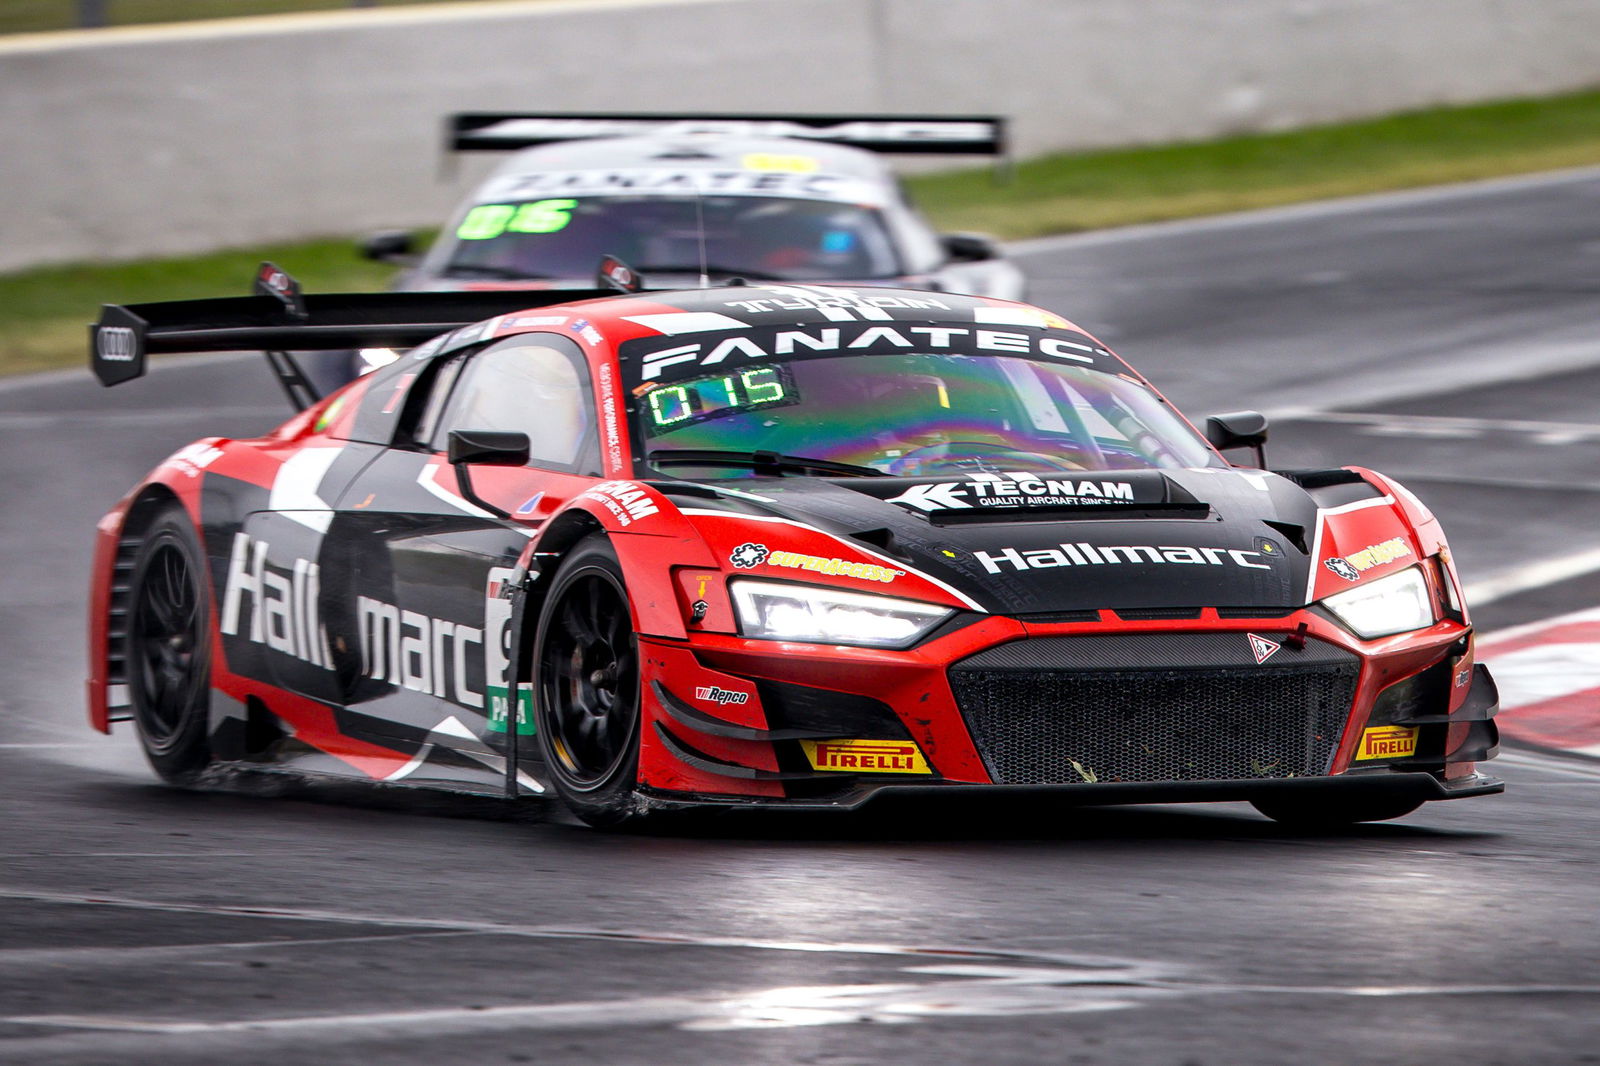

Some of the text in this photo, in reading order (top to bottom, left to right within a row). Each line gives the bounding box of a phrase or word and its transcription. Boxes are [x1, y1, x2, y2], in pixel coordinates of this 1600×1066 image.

[642, 326, 1094, 381] FANATEC
[965, 480, 1134, 500] TECNAM
[979, 496, 1024, 506] QUALITY
[1027, 497, 1078, 505] AIRCRAFT
[973, 543, 1272, 575] Hallmarc
[709, 686, 748, 704] Repco
[1366, 731, 1414, 755] PIRELLI
[816, 744, 915, 769] PIRELLI
